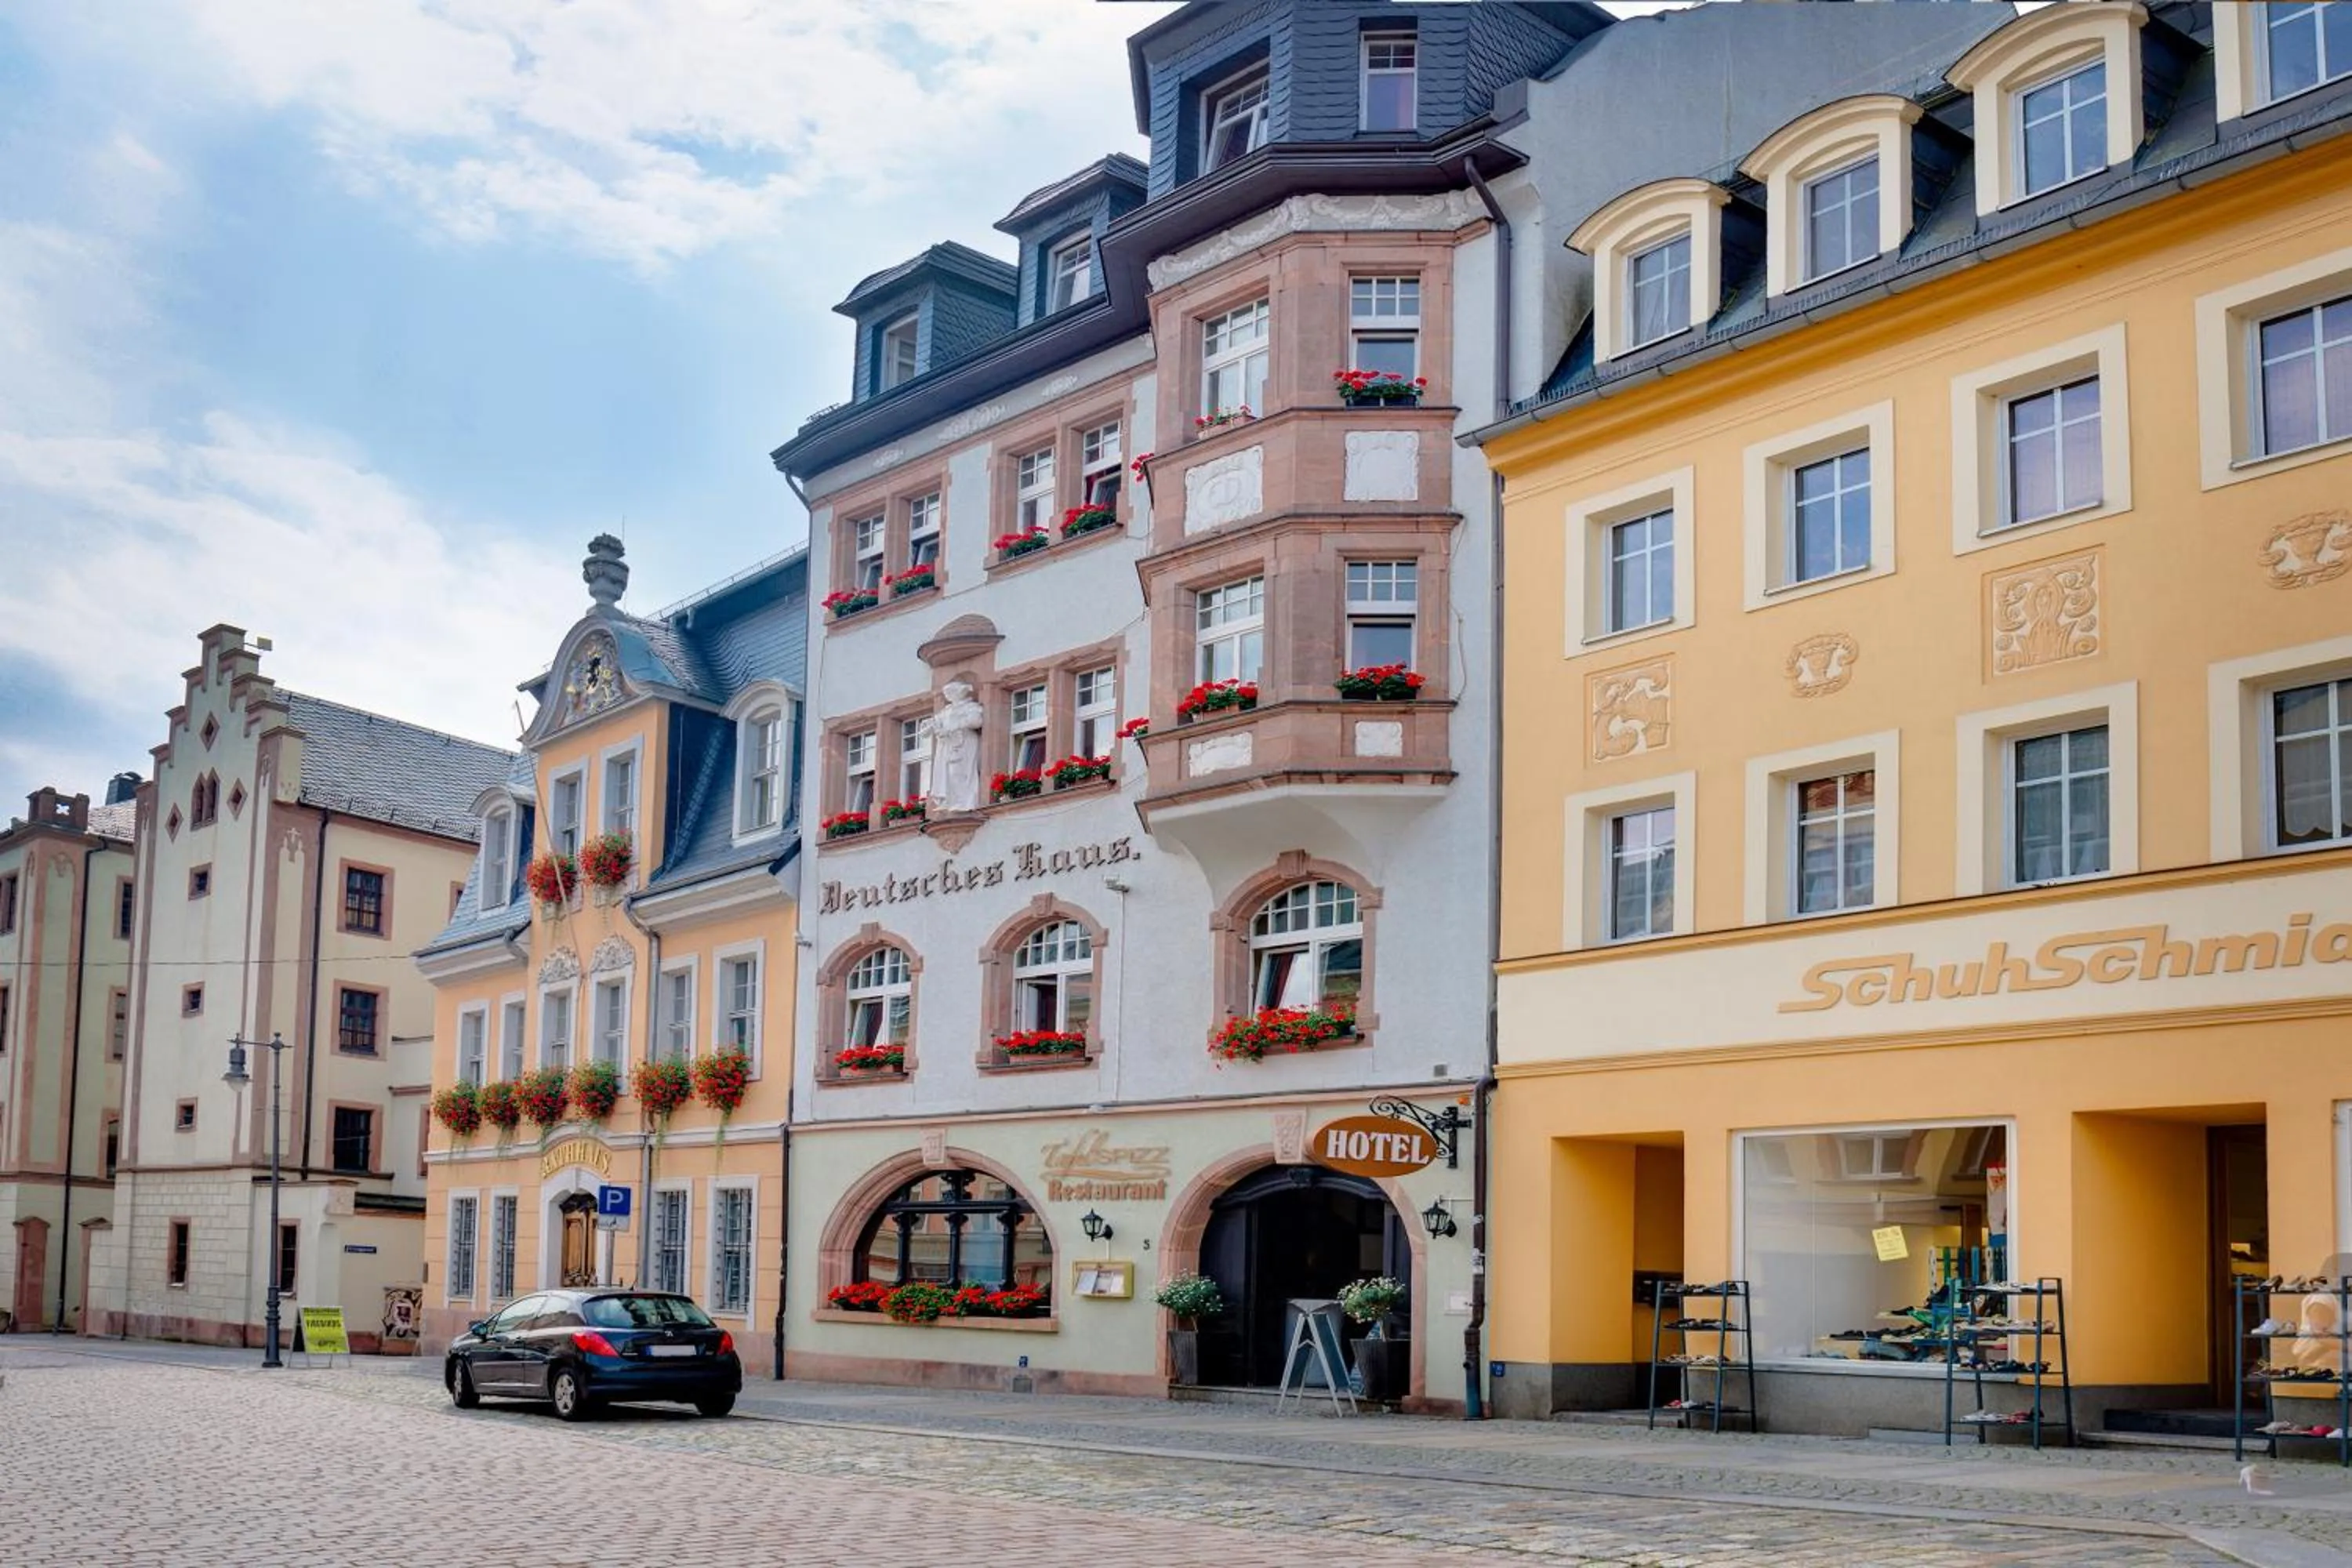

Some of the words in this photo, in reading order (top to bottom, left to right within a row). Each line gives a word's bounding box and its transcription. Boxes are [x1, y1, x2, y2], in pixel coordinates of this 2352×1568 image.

[819, 858, 1004, 915] Deutsches
[1326, 1129, 1430, 1165] HOTEL
[605, 1189, 624, 1212] P
[1047, 1178, 1167, 1202] Restaurant
